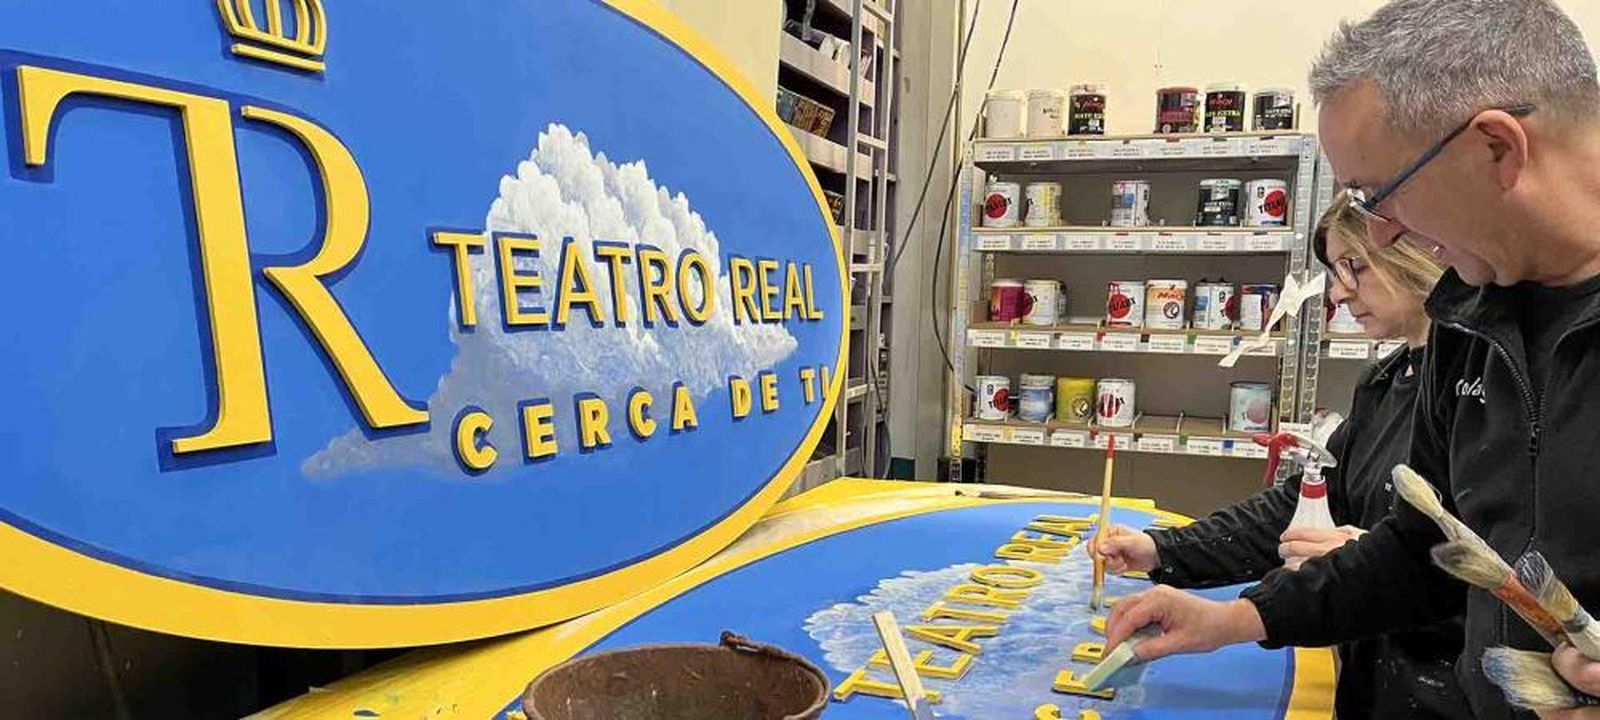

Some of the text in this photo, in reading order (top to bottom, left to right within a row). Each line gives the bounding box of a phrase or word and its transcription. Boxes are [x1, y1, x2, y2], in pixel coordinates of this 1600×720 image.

[432, 230, 823, 328] TEATRO REAL
[456, 365, 830, 471] CERCA DE TI
[832, 512, 1098, 706] TEATRO REAL
